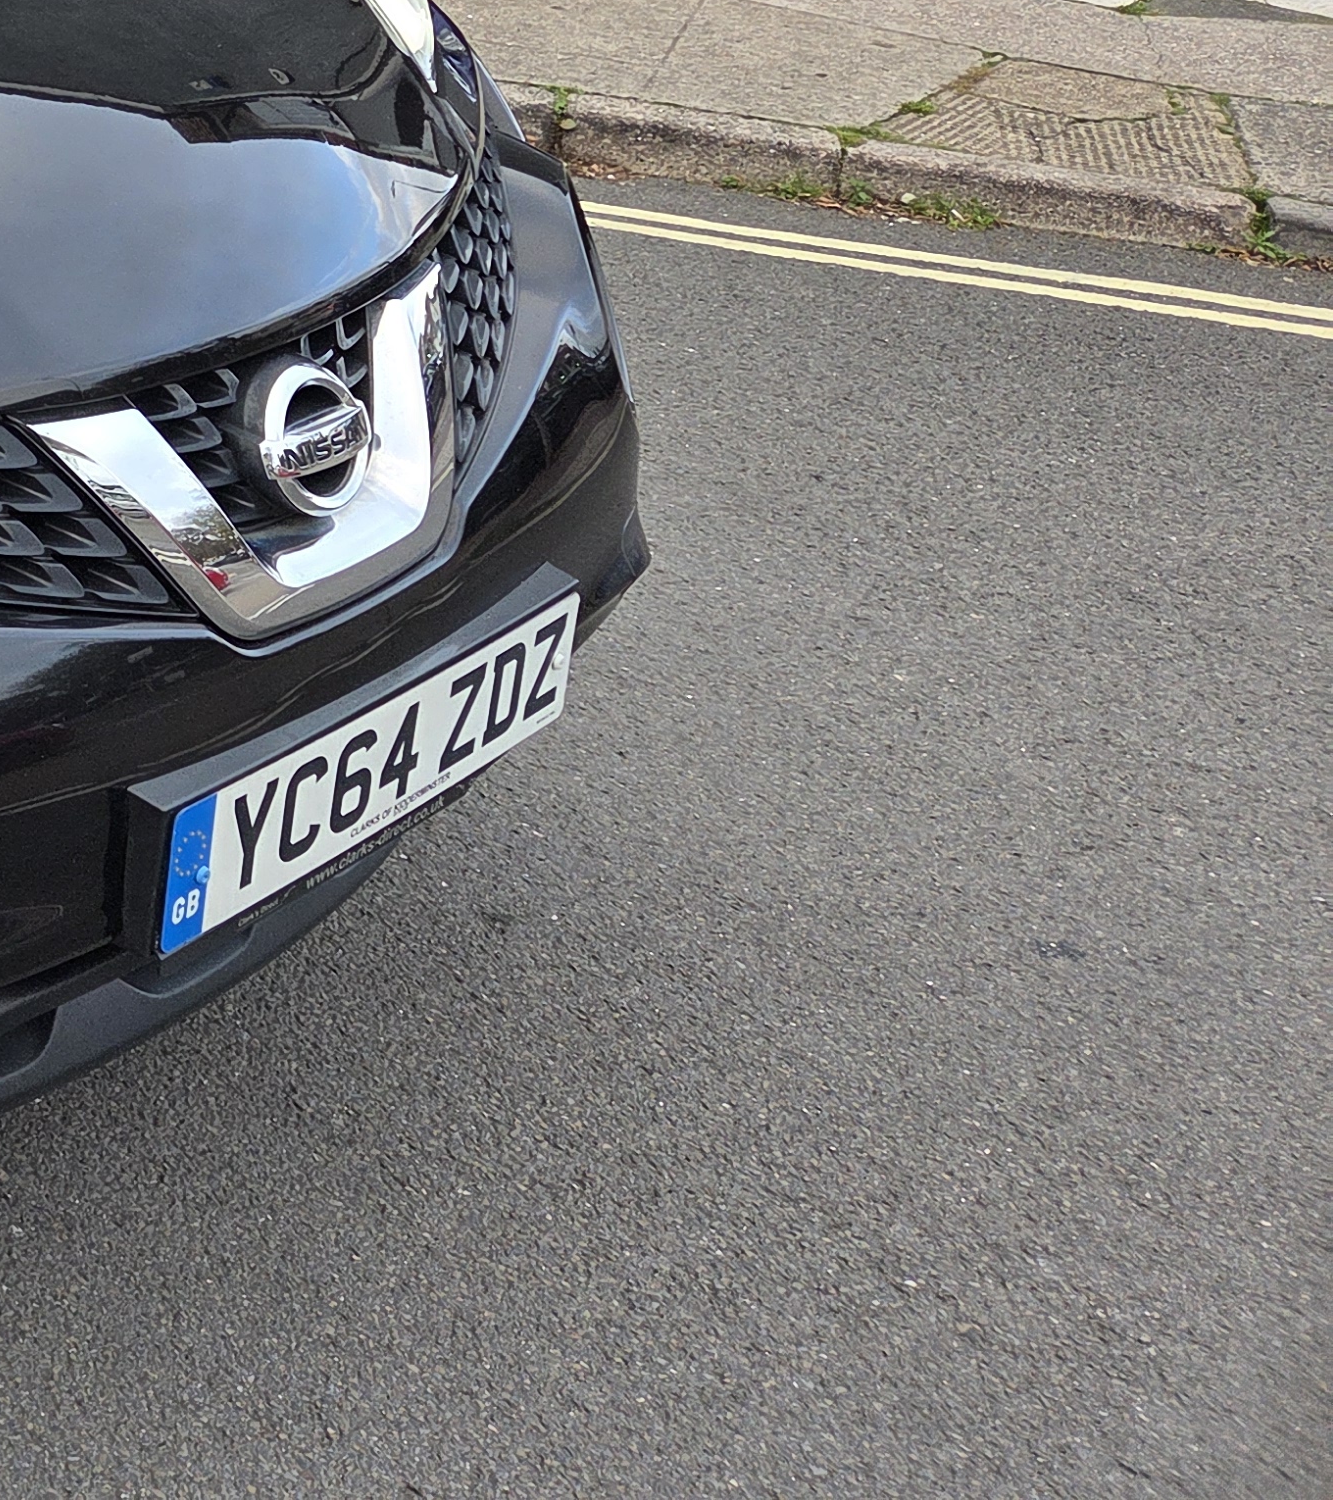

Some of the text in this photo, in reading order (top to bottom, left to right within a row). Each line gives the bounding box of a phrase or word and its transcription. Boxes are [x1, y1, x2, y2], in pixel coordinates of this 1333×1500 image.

[279, 414, 367, 470] NISSAN
[234, 613, 568, 890] YC64 ZDZ
[350, 813, 381, 838] CLARKS
[381, 807, 394, 821] OF
[171, 888, 200, 926] GB
